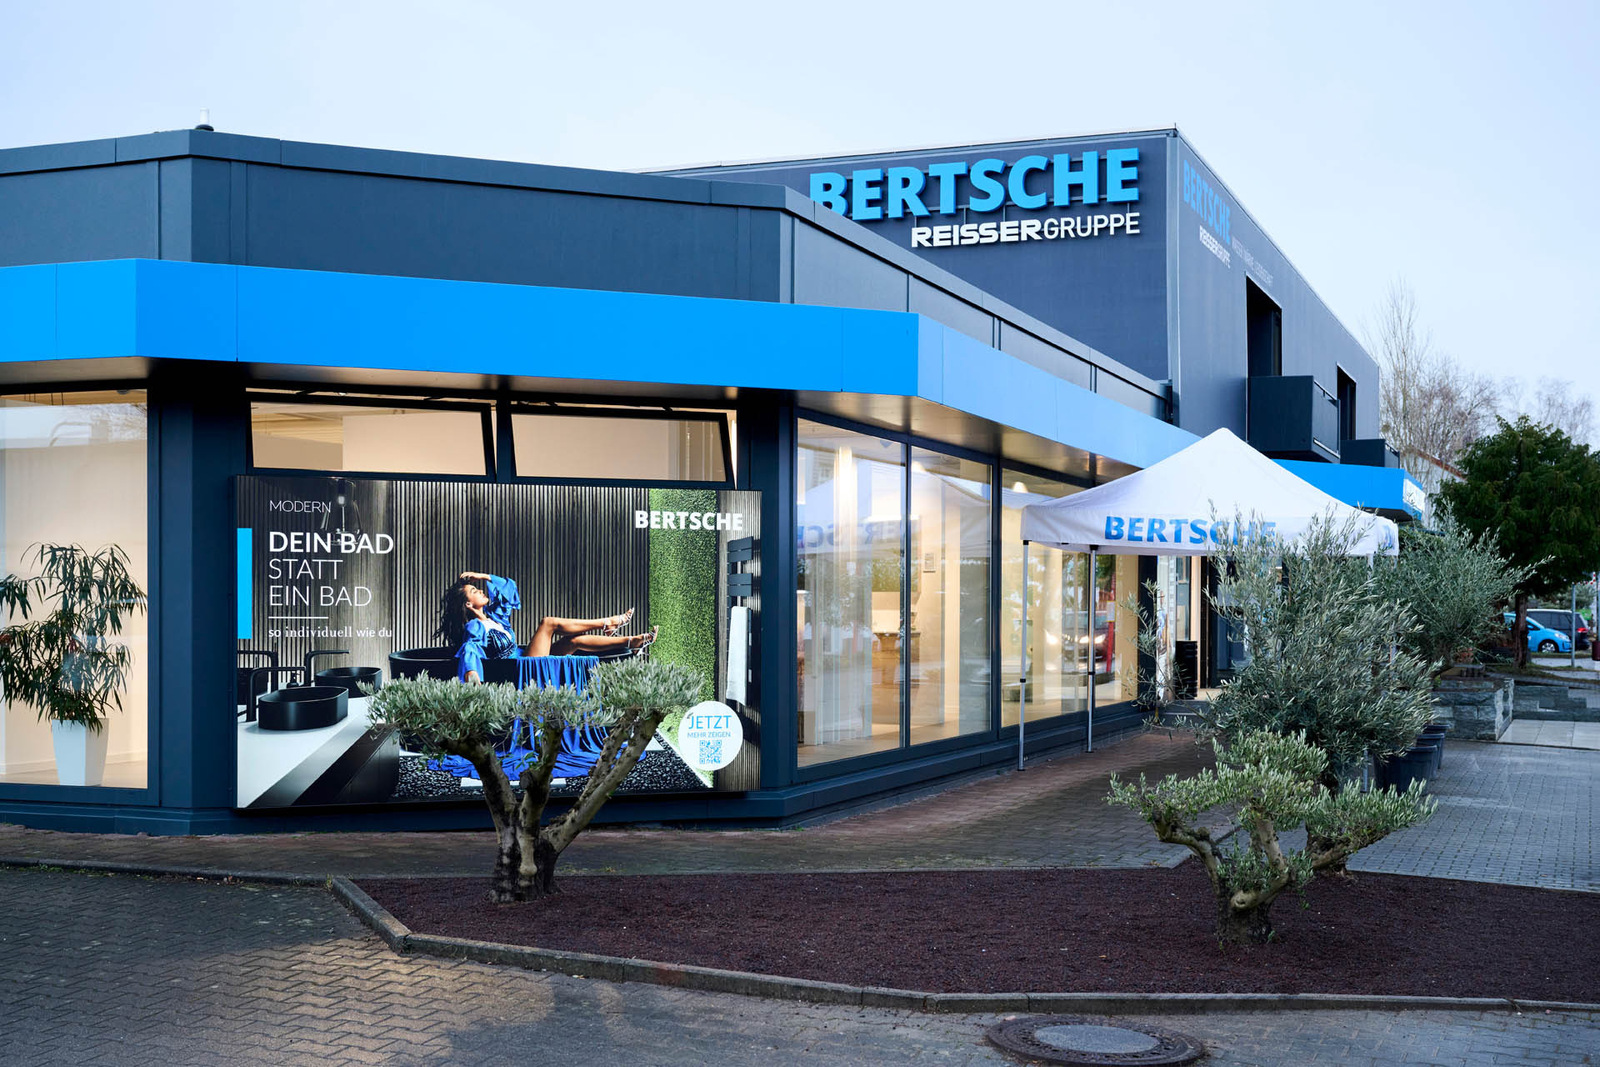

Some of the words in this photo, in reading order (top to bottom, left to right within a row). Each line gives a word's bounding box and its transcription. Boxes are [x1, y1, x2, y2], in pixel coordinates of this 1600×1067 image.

[810, 148, 1139, 220] BERTSCHE
[911, 212, 1141, 248] REISSERGRUPPE
[269, 500, 332, 513] MODERN
[635, 510, 743, 531] BERTSCHE
[269, 531, 331, 553] DEIN
[341, 533, 394, 554] BAD
[268, 558, 344, 580] STATT
[270, 585, 310, 606] EIN
[320, 586, 372, 607] BAD
[268, 629, 281, 638] so
[285, 626, 352, 638] individuell
[356, 627, 375, 638] wie
[378, 627, 392, 638] du
[688, 715, 732, 729] JETZT
[687, 731, 706, 739] MEHR
[708, 731, 731, 739] ZEIGEN
